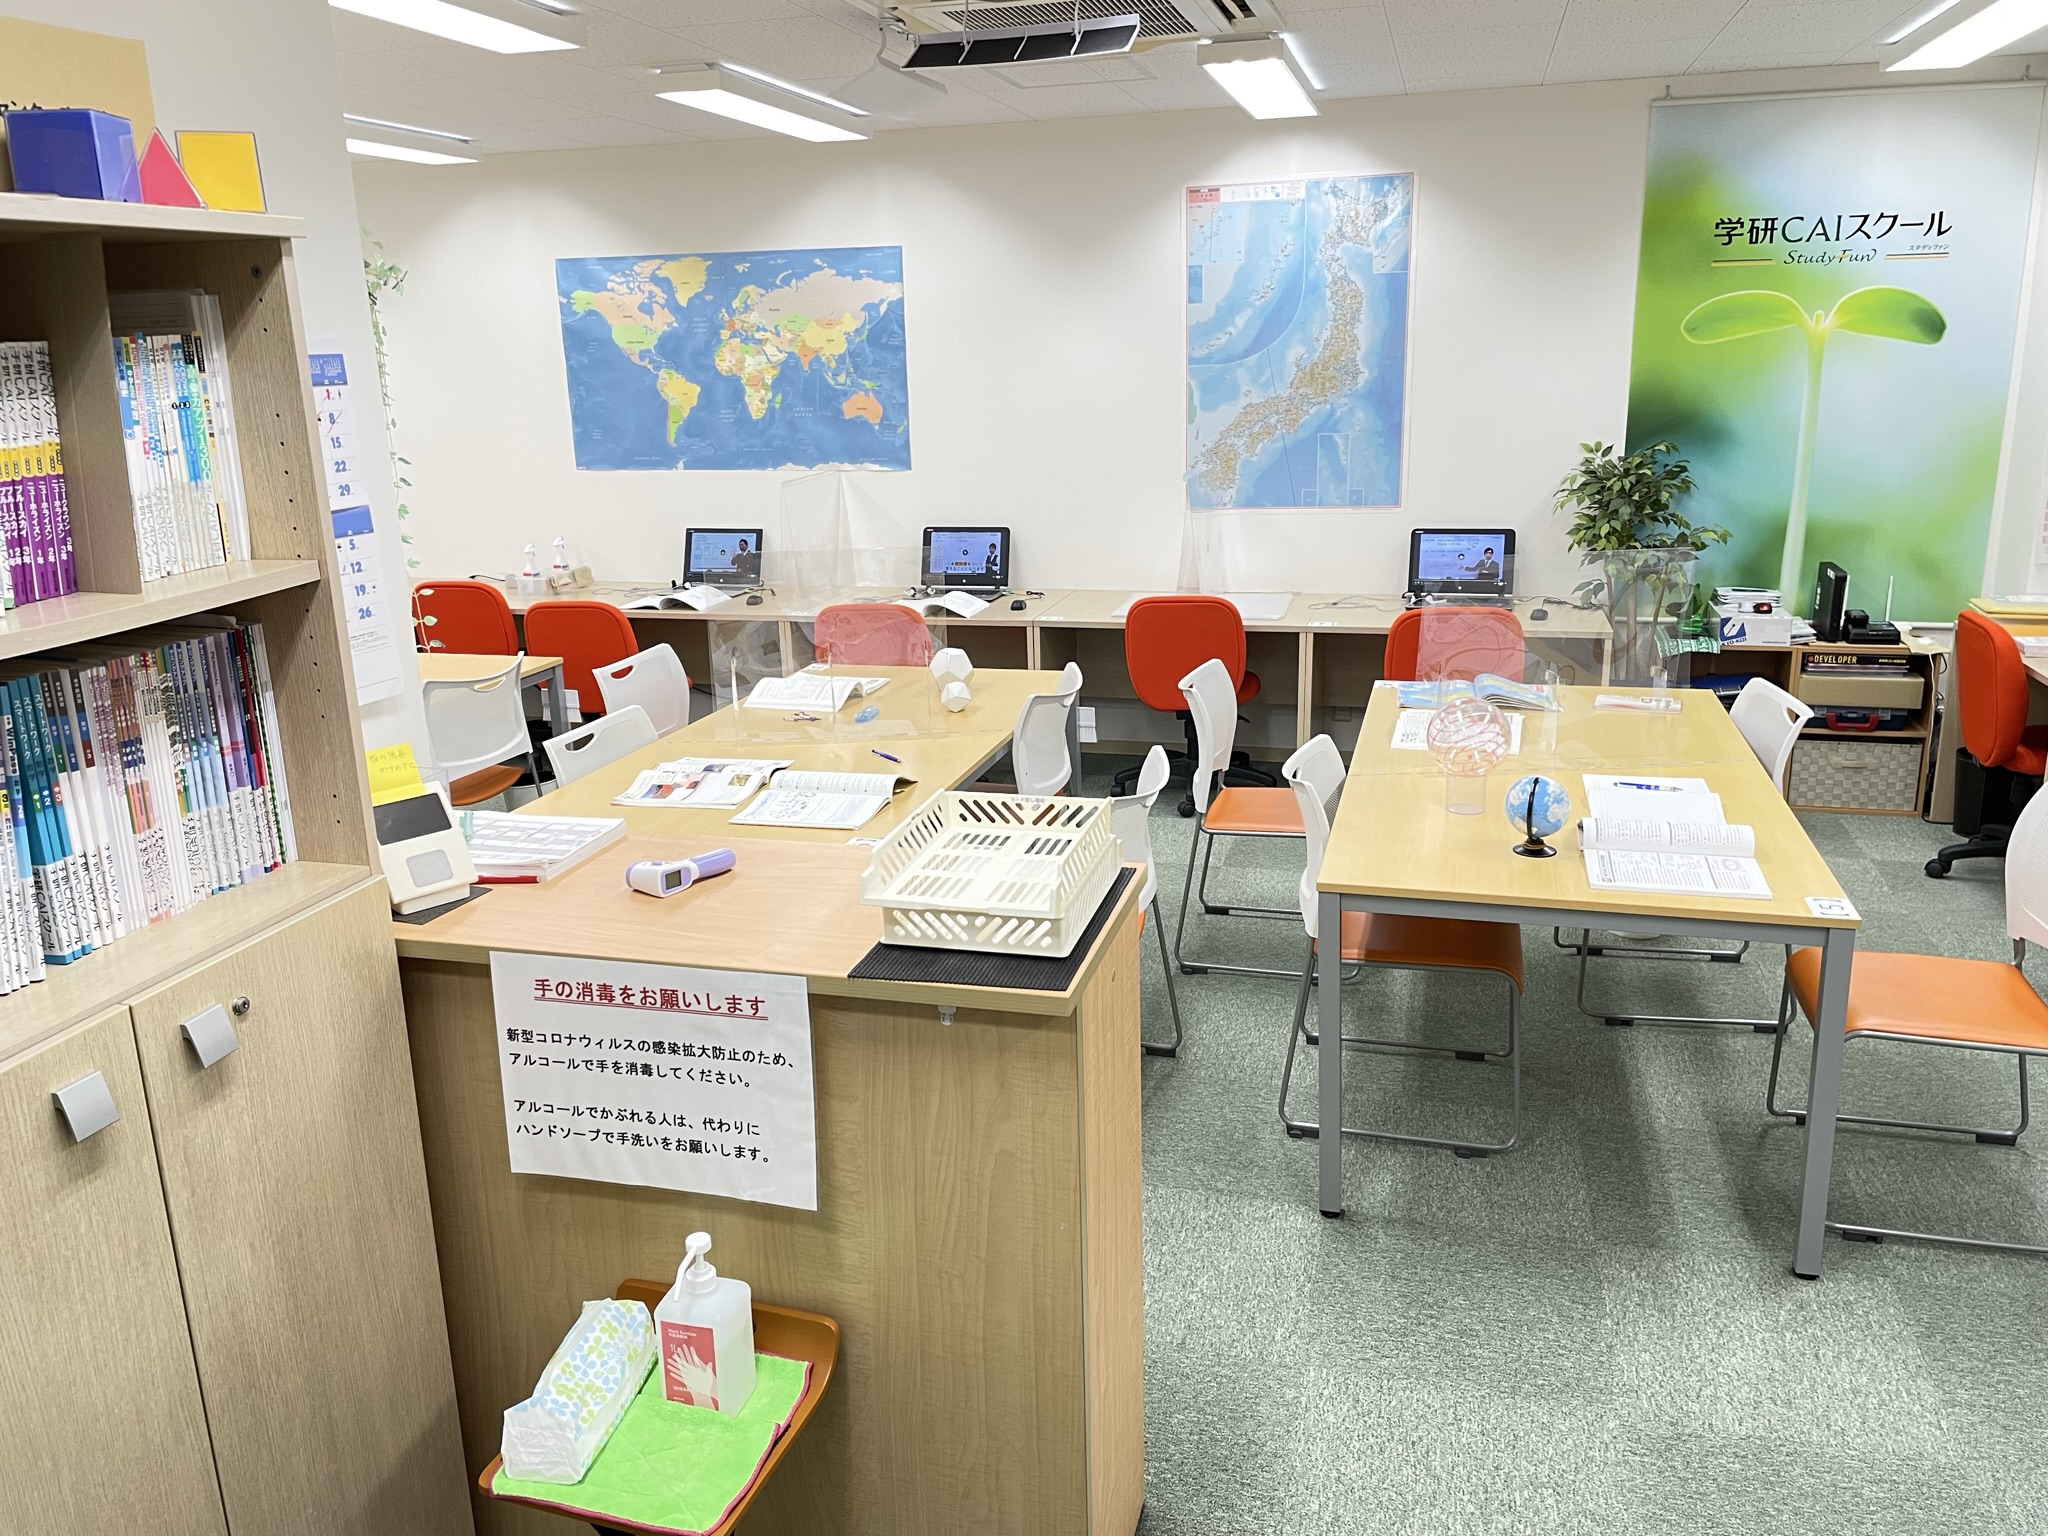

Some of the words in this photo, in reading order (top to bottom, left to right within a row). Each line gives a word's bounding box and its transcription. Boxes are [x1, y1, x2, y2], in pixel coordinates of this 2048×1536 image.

[1713, 211, 1953, 246] 学研CAIスクール
[328, 412, 336, 425] 8
[330, 436, 342, 449] 15
[334, 460, 347, 473] 22
[58, 479, 70, 531] ニュークラウン
[338, 483, 351, 497] 29
[14, 485, 28, 538] ブルースカイ
[23, 546, 31, 565] 3年
[27, 481, 42, 542] ニューホライズン
[37, 549, 45, 565] 1年
[38, 481, 53, 541] ニューホライズン
[48, 547, 56, 563] 2年
[51, 479, 65, 539] ニューホライズン
[60, 545, 69, 561] 3年
[15, 547, 22, 566] 2年
[349, 538, 356, 551] 5
[350, 561, 363, 574] 12
[354, 584, 367, 597] 19
[358, 606, 372, 620] 26
[1814, 654, 1857, 664] DEVELOPER
[13, 700, 31, 760] スマートワーク
[23, 697, 41, 756] スマートワーク
[34, 694, 51, 754] スマートワーク
[534, 978, 767, 1016] 手の消毒をお願いします
[506, 1027, 795, 1069] 新型コロナウィルスの感染拡大防止のため、
[508, 1052, 751, 1088] アルコールで手を消毒してください。
[513, 1100, 761, 1137] アルコールでかぶれる人は、代わりに
[516, 1123, 770, 1164] ハンドソープで手洗いをお願いします。
